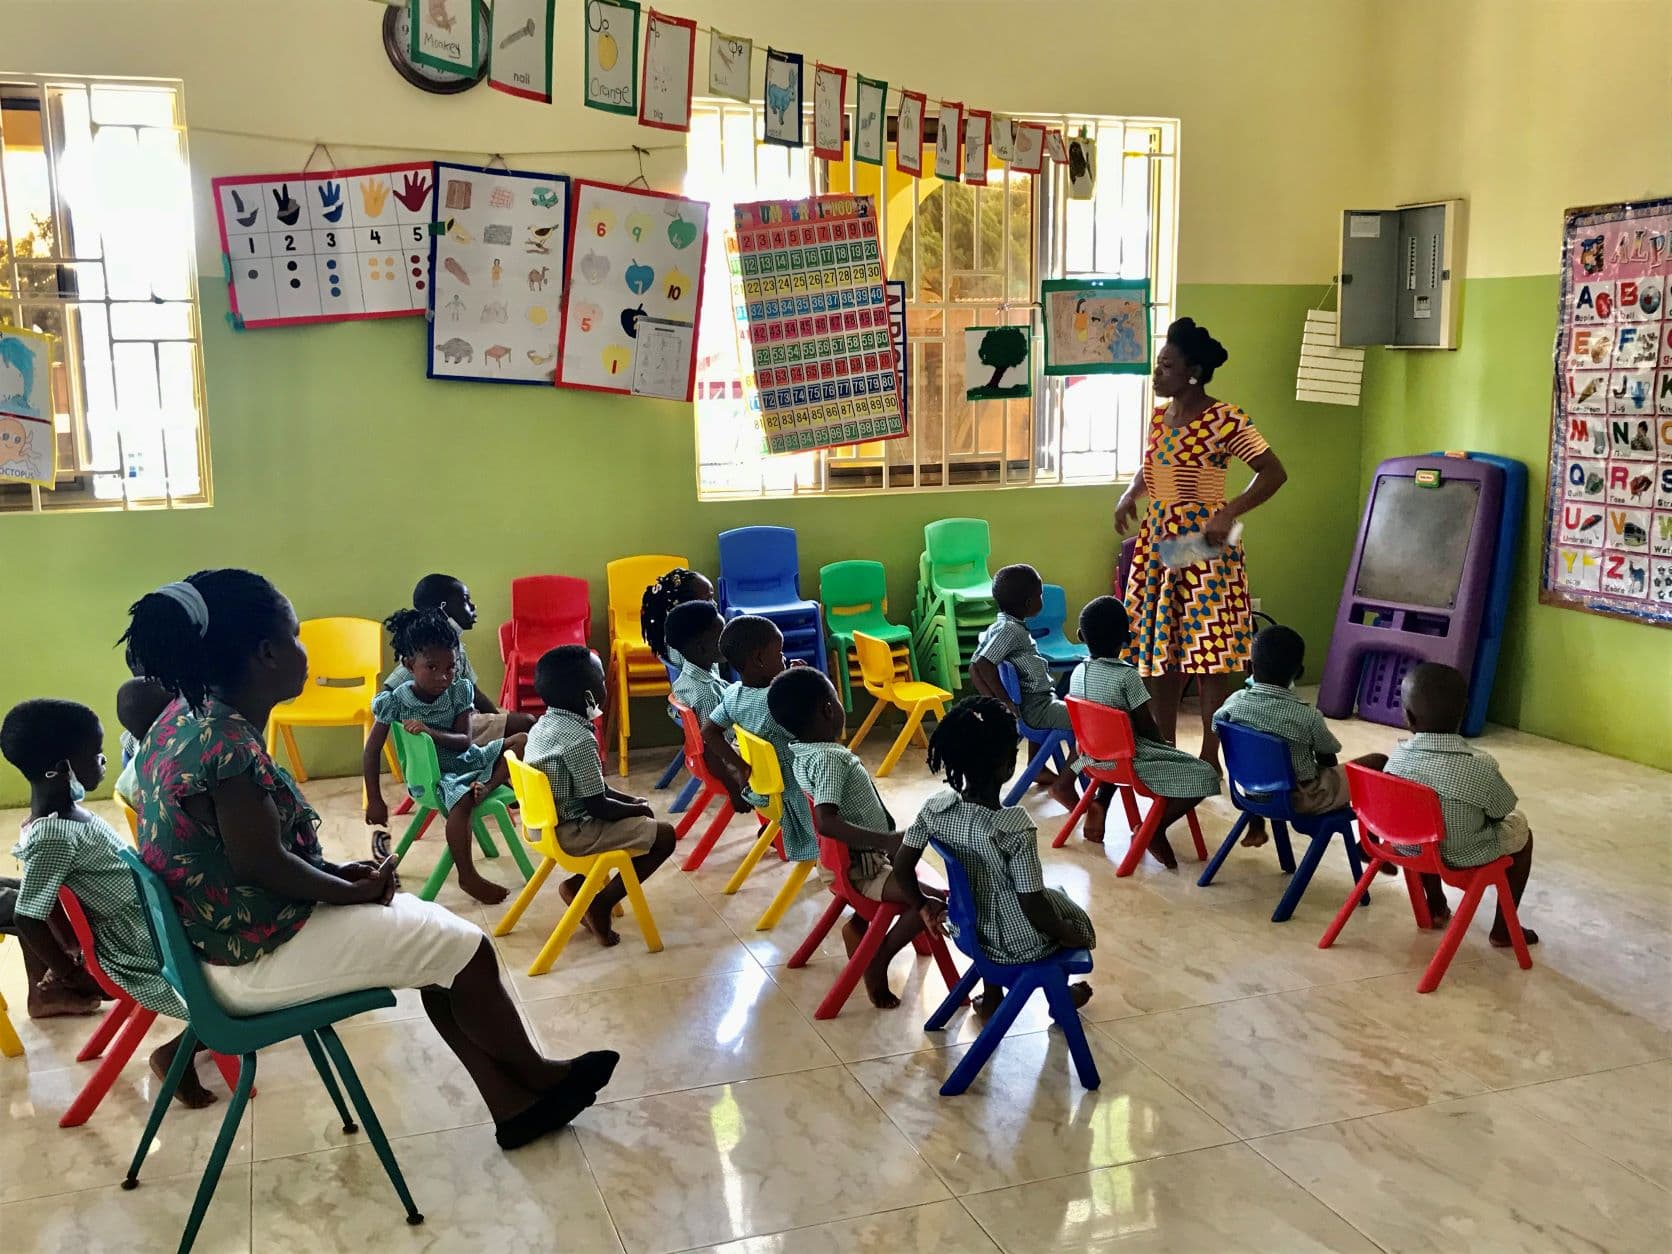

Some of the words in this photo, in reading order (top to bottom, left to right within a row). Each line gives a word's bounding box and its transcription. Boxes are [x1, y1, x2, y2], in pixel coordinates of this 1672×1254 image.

[424, 32, 462, 58] Monkey
[513, 73, 530, 85] nail
[590, 77, 631, 104] Orange
[249, 237, 255, 253] 1
[285, 235, 296, 252] 2
[326, 233, 336, 247] 3
[370, 229, 382, 244] 4
[413, 227, 423, 241] 5
[597, 222, 606, 237] 6
[632, 226, 642, 242] 9
[743, 237, 750, 247] 2
[759, 235, 765, 246] 3
[774, 233, 780, 244] 4
[789, 231, 795, 242] 5
[804, 229, 810, 241] 6
[819, 228, 826, 239] 7
[834, 226, 841, 237] 8
[849, 224, 856, 236] 9
[745, 260, 756, 270] 12
[760, 258, 771, 269] 13
[775, 256, 786, 267] 14
[790, 254, 801, 265] 15
[805, 252, 816, 263] 16
[820, 250, 831, 261] 17
[835, 248, 846, 260] 18
[850, 246, 861, 258] 19
[866, 244, 876, 256] 20
[1610, 231, 1672, 269] ALP
[747, 282, 759, 293] 22
[762, 280, 774, 291] 23
[777, 278, 789, 289] 24
[793, 276, 804, 287] 25
[808, 274, 819, 285] 26
[823, 272, 834, 283] 27
[838, 270, 849, 281] 28
[853, 268, 864, 279] 29
[868, 266, 879, 277] 30
[667, 284, 681, 300] 10
[751, 305, 762, 316] 32
[766, 303, 777, 314] 33
[781, 301, 792, 312] 34
[796, 299, 807, 310] 35
[811, 297, 822, 307] 36
[826, 294, 837, 305] 37
[842, 292, 852, 303] 38
[857, 290, 867, 301] 39
[872, 288, 882, 299] 40
[1576, 285, 1594, 309] A
[1621, 282, 1638, 306] B
[581, 318, 591, 332] 5
[758, 351, 769, 361] 52
[772, 348, 784, 359] 53
[787, 346, 798, 357] 54
[802, 344, 813, 355] 55
[817, 342, 828, 352] 56
[832, 339, 843, 350] 57
[847, 337, 858, 348] 58
[862, 335, 873, 346] 59
[876, 333, 888, 344] 60
[1574, 331, 1591, 355] E
[1619, 329, 1637, 352] F
[611, 360, 617, 374] 1
[763, 395, 775, 407] 72
[778, 393, 790, 405] 73
[793, 390, 804, 402] 74
[808, 388, 819, 400] 75
[823, 386, 834, 397] 76
[838, 383, 848, 395] 77
[852, 381, 863, 392] 78
[867, 379, 878, 390] 79
[882, 376, 893, 387] 80
[1569, 376, 1575, 398] I
[1613, 375, 1628, 399] J
[1660, 374, 1672, 398] K
[767, 417, 778, 427] 82
[782, 414, 793, 425] 83
[797, 412, 808, 422] 84
[811, 409, 823, 420] 85
[826, 407, 837, 417] 86
[841, 404, 852, 415] 87
[856, 402, 867, 412] 88
[870, 399, 882, 410] 89
[885, 397, 896, 408] 90
[1570, 419, 1589, 442] M
[1612, 421, 1629, 445] N
[0, 468, 35, 479] OCTOPUS
[1569, 463, 1585, 486] Q
[1610, 466, 1628, 490] R
[1565, 506, 1581, 530] U
[1610, 511, 1626, 535] V
[1561, 550, 1578, 573] Y
[1607, 555, 1625, 580] Z
